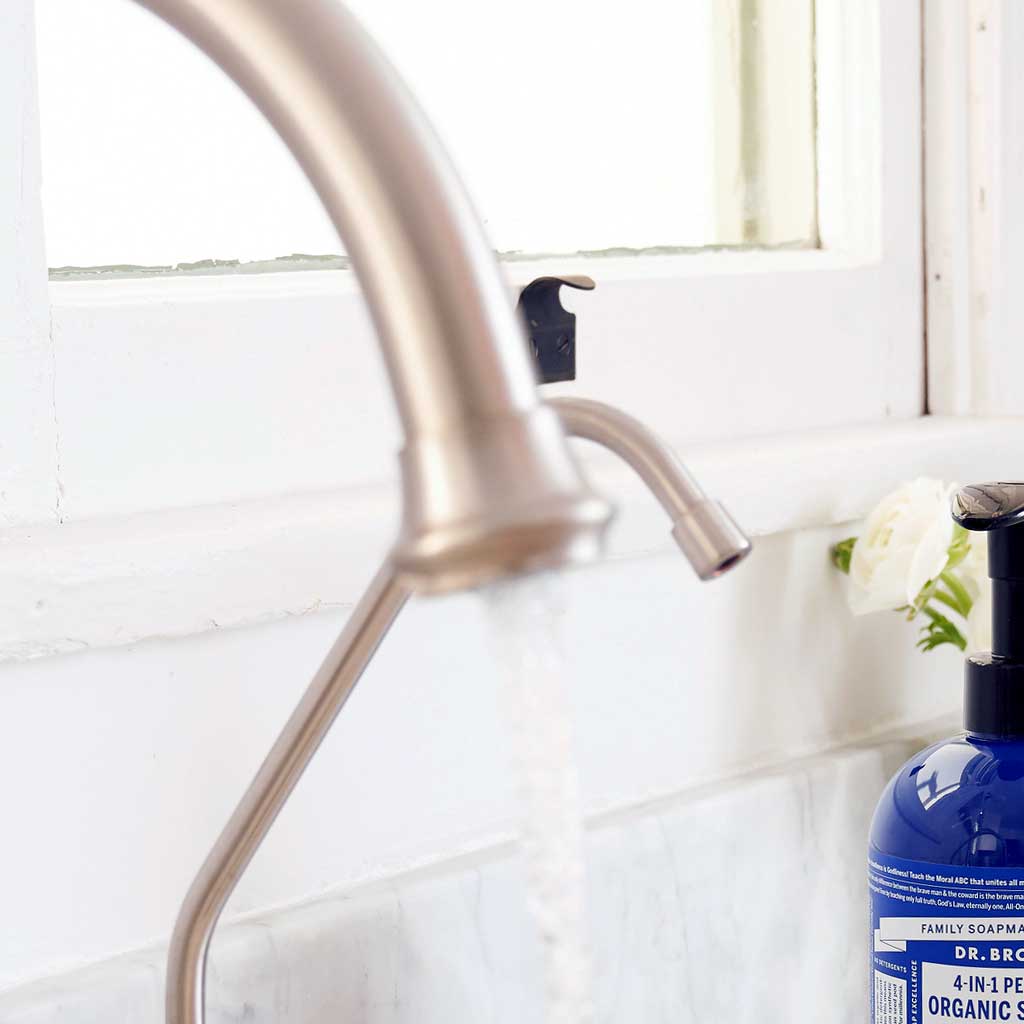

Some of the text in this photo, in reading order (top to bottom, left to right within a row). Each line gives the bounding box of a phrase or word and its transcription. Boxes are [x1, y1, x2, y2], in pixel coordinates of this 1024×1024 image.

[910, 871, 924, 880] Teach
[936, 875, 953, 884] Moral
[921, 923, 964, 934] FAMILY
[955, 946, 985, 961] DR.
[954, 974, 998, 993] 4-IN-1
[928, 995, 1011, 1020] ORGANIC
